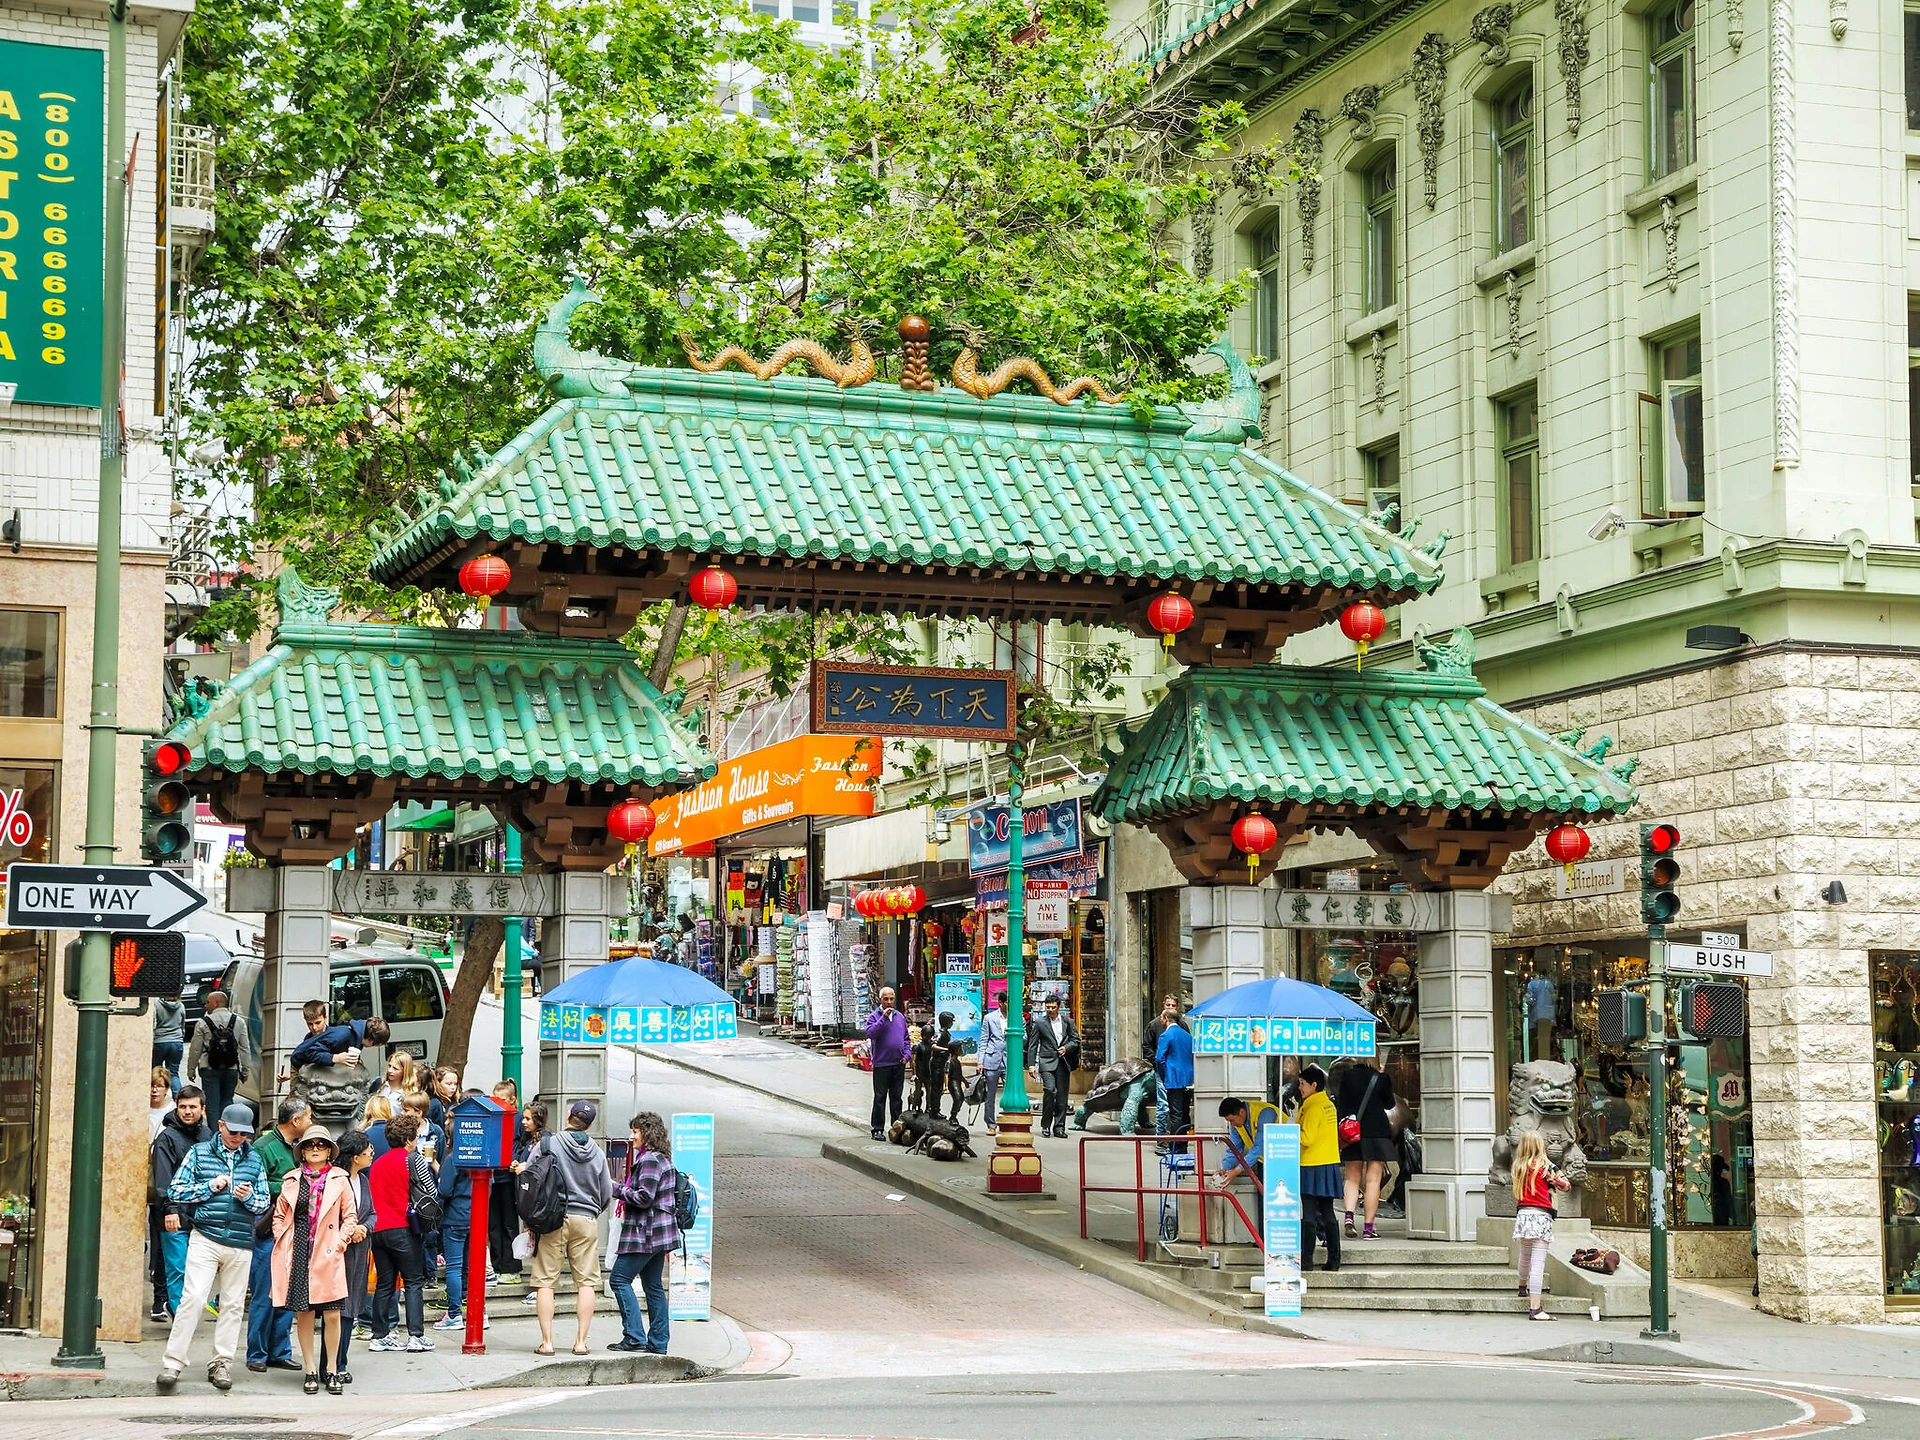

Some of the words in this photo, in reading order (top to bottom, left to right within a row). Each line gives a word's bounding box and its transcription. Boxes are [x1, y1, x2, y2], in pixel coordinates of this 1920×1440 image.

[38, 92, 76, 183] (800)
[41, 203, 68, 365] 6666696
[729, 765, 769, 805] House
[742, 808, 757, 825] Gifts
[763, 799, 794, 820] Souvenirs
[995, 807, 1048, 842] Cnon
[977, 875, 1005, 894] Canon
[1032, 881, 1062, 889] TOW-AWAY
[1564, 865, 1615, 895] Michael
[25, 886, 75, 909] ONE
[89, 888, 140, 910] WAY
[1027, 888, 1040, 899] NO
[1041, 890, 1068, 899] STOPPING
[1037, 912, 1059, 921] TIME
[1038, 903, 1057, 912] ANY
[1717, 935, 1736, 946] 500
[949, 964, 969, 972] ATM
[1696, 951, 1746, 970] BUSH
[718, 1012, 732, 1025] Fa
[1273, 1025, 1292, 1040] Fa
[1298, 1026, 1321, 1041] Lun
[1325, 1027, 1342, 1040] Da
[1360, 1028, 1370, 1042] is
[1722, 1080, 1740, 1101] M
[460, 1121, 482, 1129] POLICE
